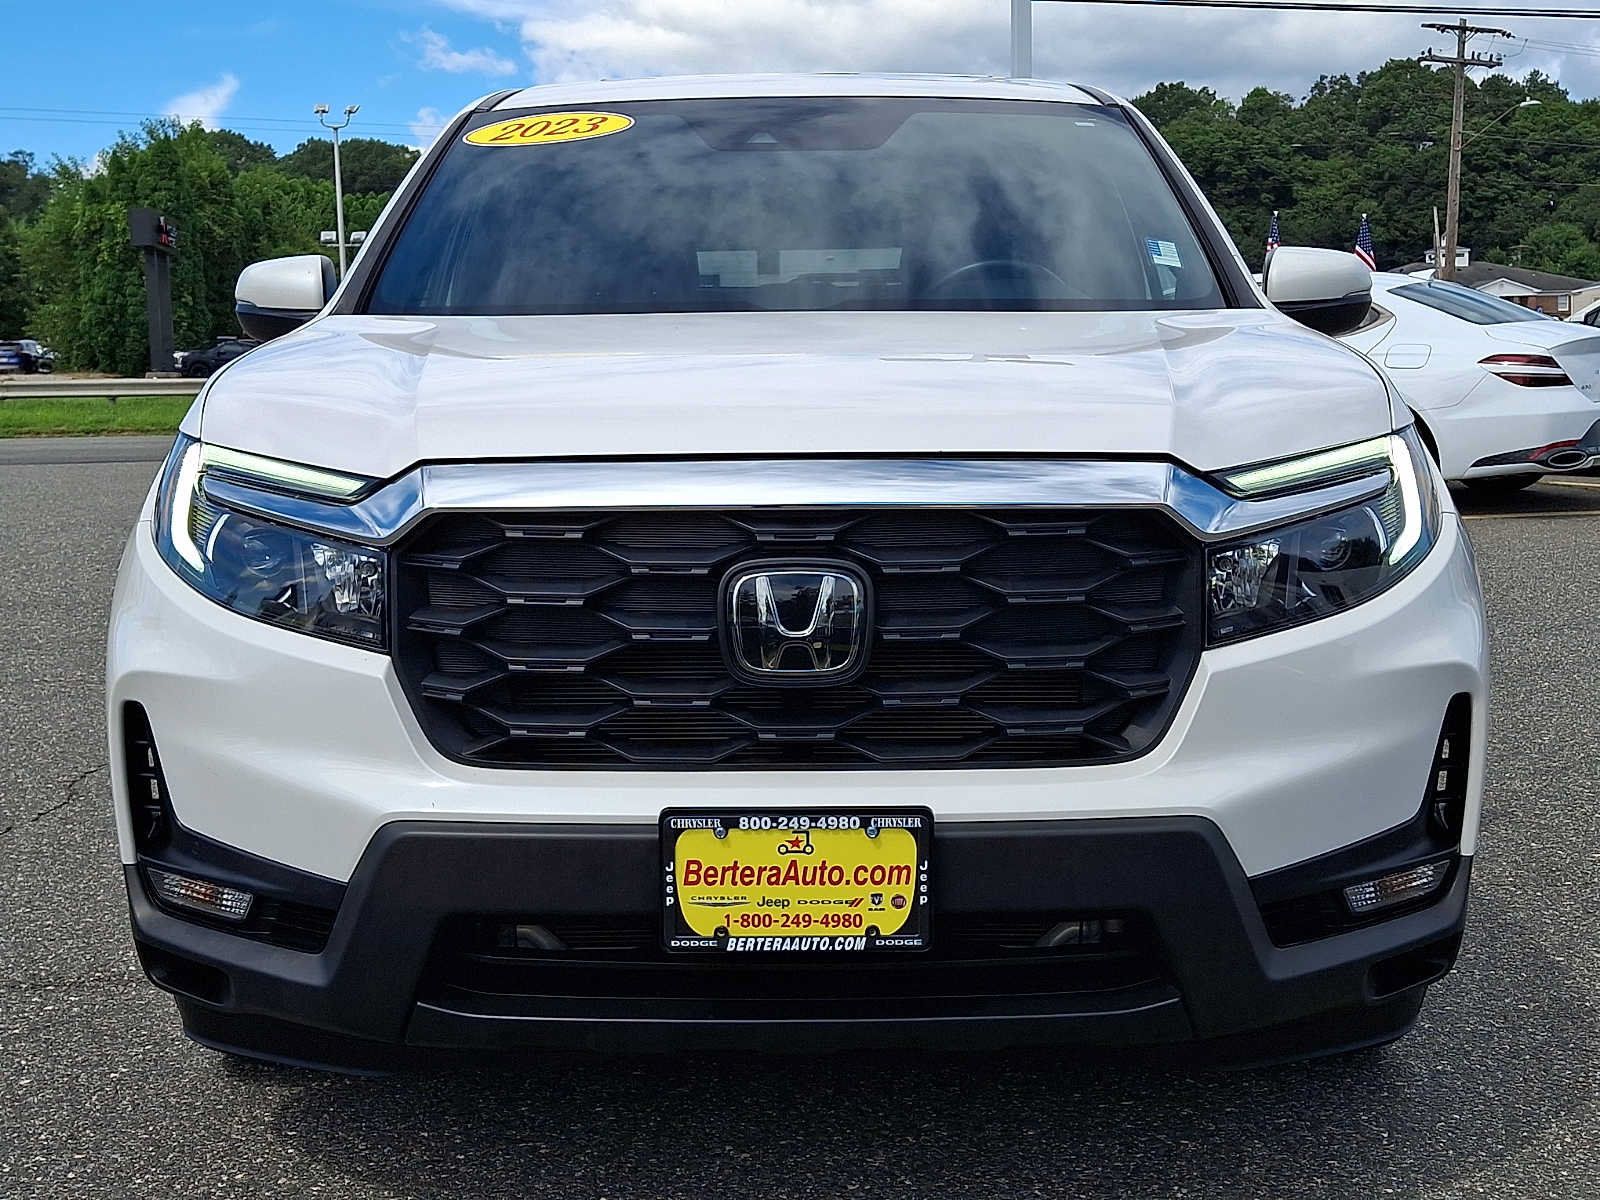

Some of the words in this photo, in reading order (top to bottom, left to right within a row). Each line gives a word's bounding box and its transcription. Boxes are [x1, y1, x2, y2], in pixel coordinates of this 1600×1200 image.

[488, 116, 609, 142] 2023
[670, 818, 721, 829] CHRYSLER
[739, 816, 861, 830] 800-249-4980
[870, 817, 922, 828] CHRYSLER
[683, 859, 912, 886] BerteraAuto.com
[665, 861, 675, 907] Jeep
[919, 860, 928, 905] Jeep
[756, 896, 791, 909] Jeep
[724, 913, 863, 928] 1-800-249-4980
[726, 937, 867, 951] BERTERAAUTO.COM
